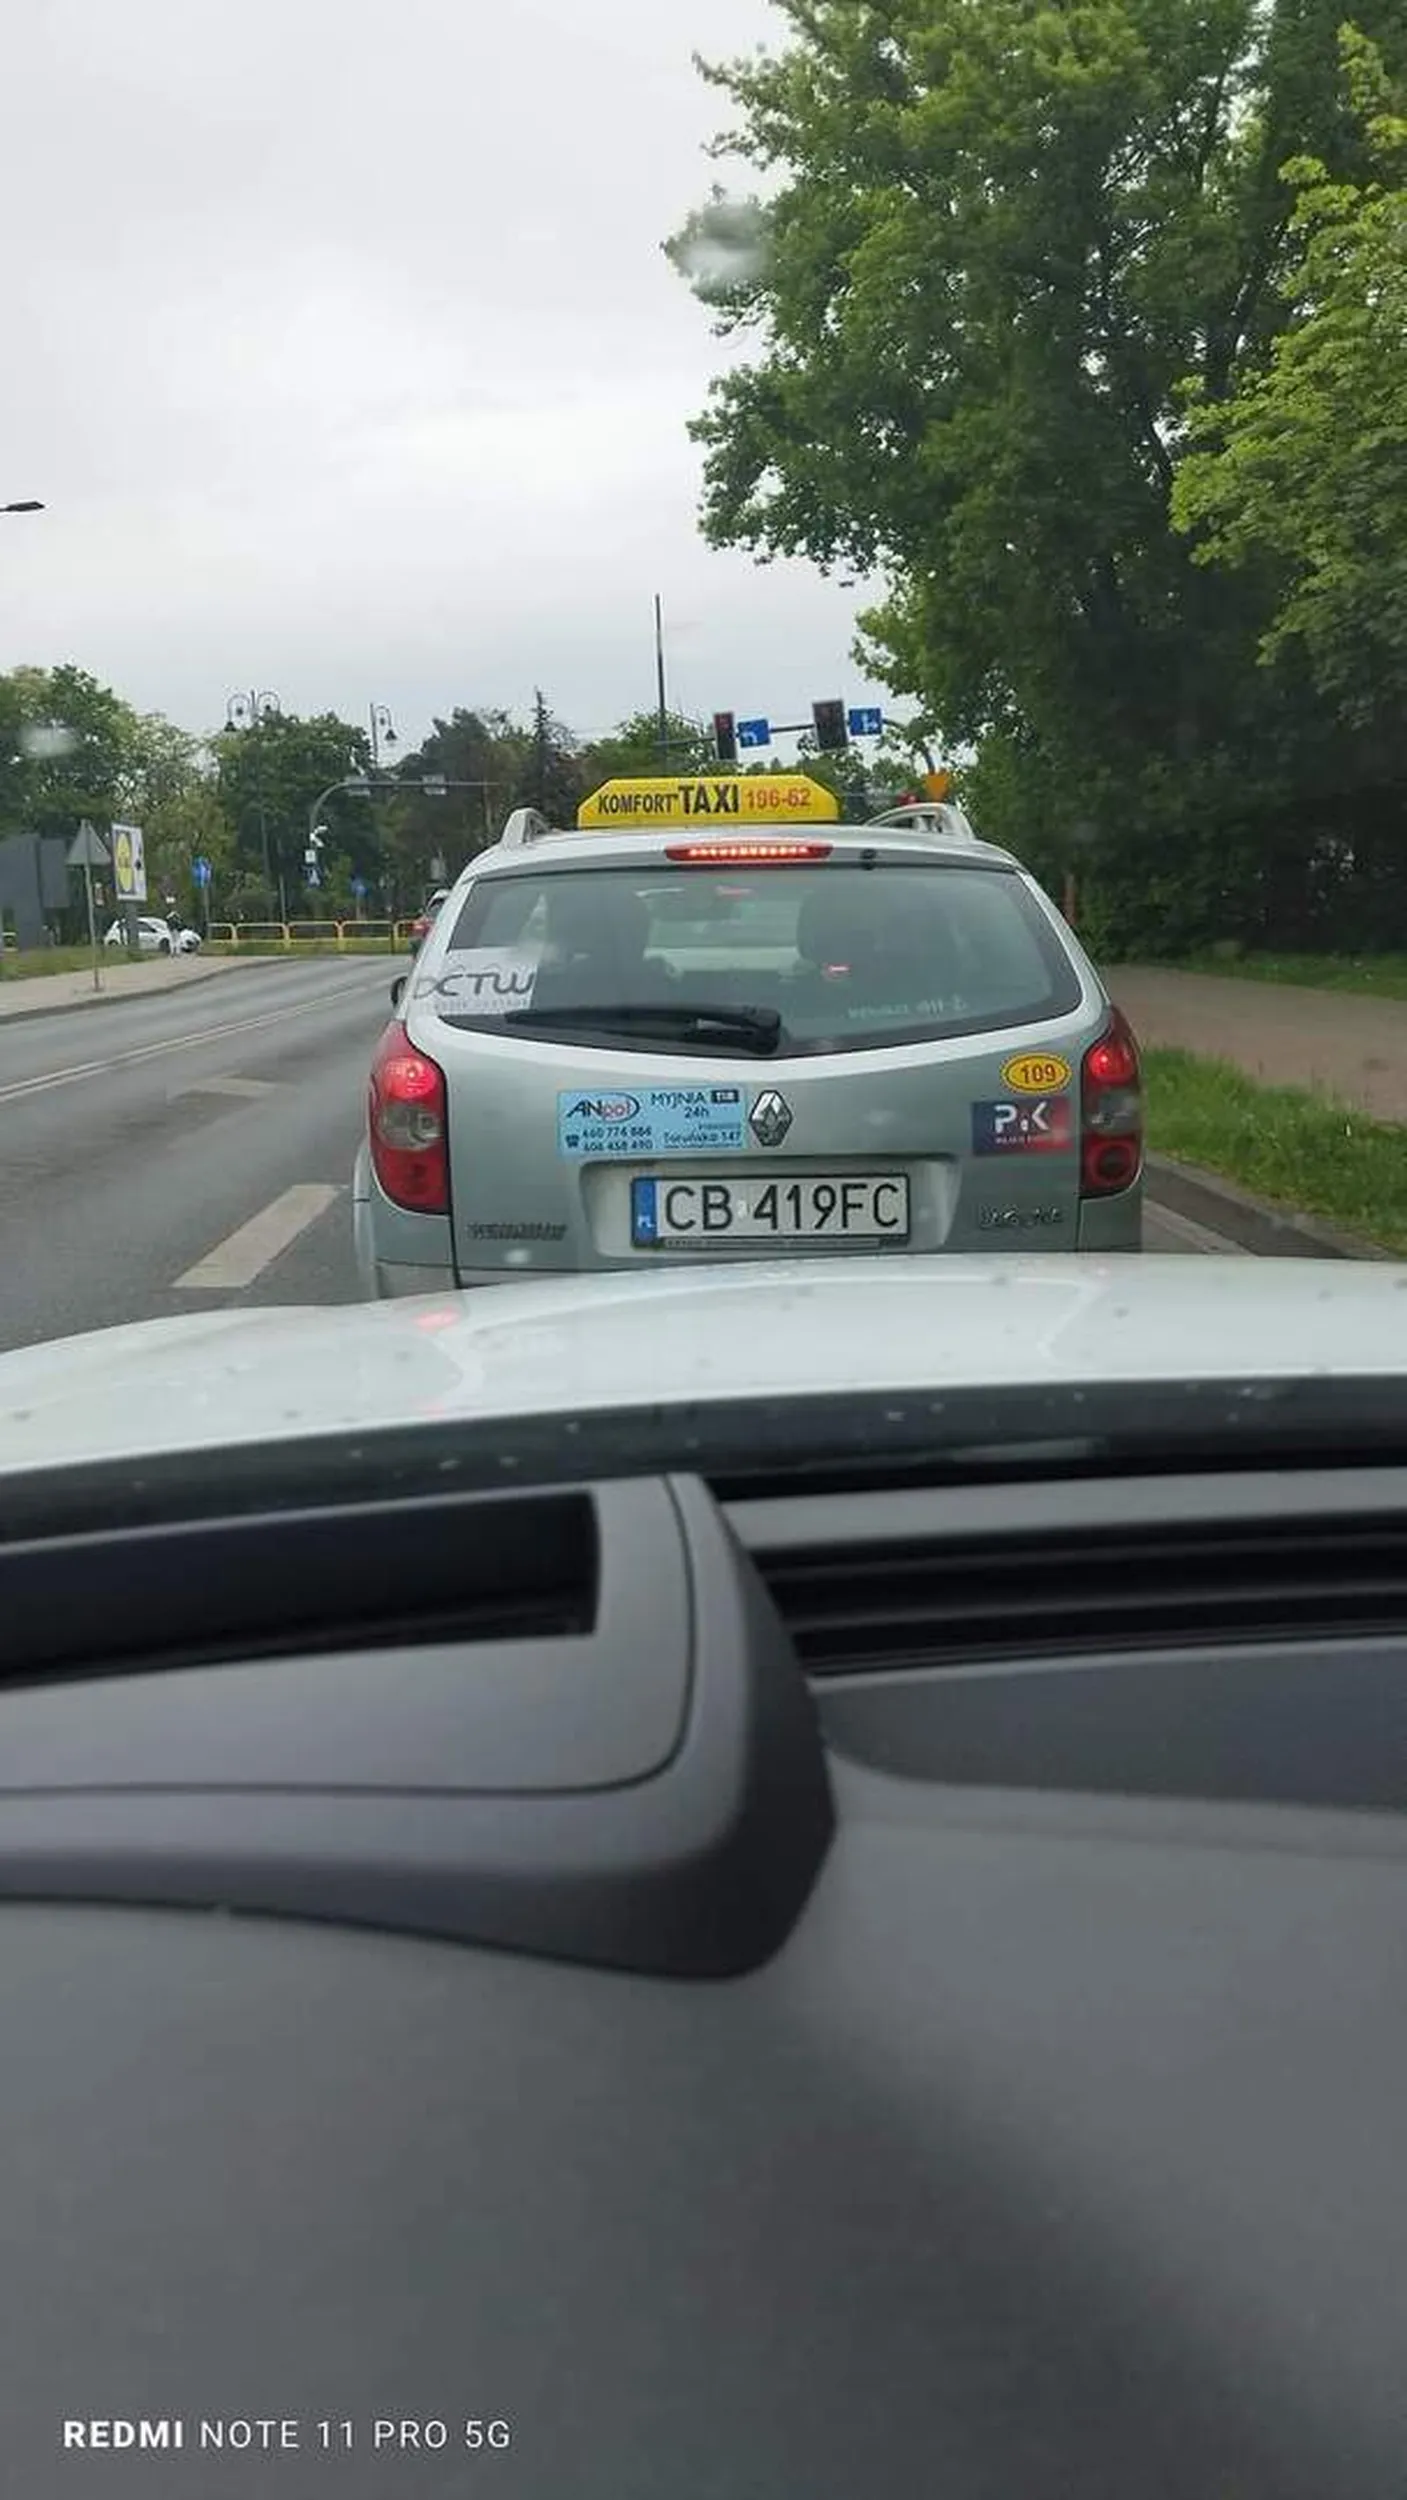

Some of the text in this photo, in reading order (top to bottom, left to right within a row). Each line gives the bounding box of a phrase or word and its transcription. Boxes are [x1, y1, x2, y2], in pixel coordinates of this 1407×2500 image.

[678, 784, 739, 814] TAXI
[746, 788, 812, 810] 196-62
[1021, 1063, 1056, 1084] 109
[651, 1091, 707, 1109] MYJNIA
[684, 1106, 709, 1118] 24h
[665, 1183, 899, 1231] CB 419FC
